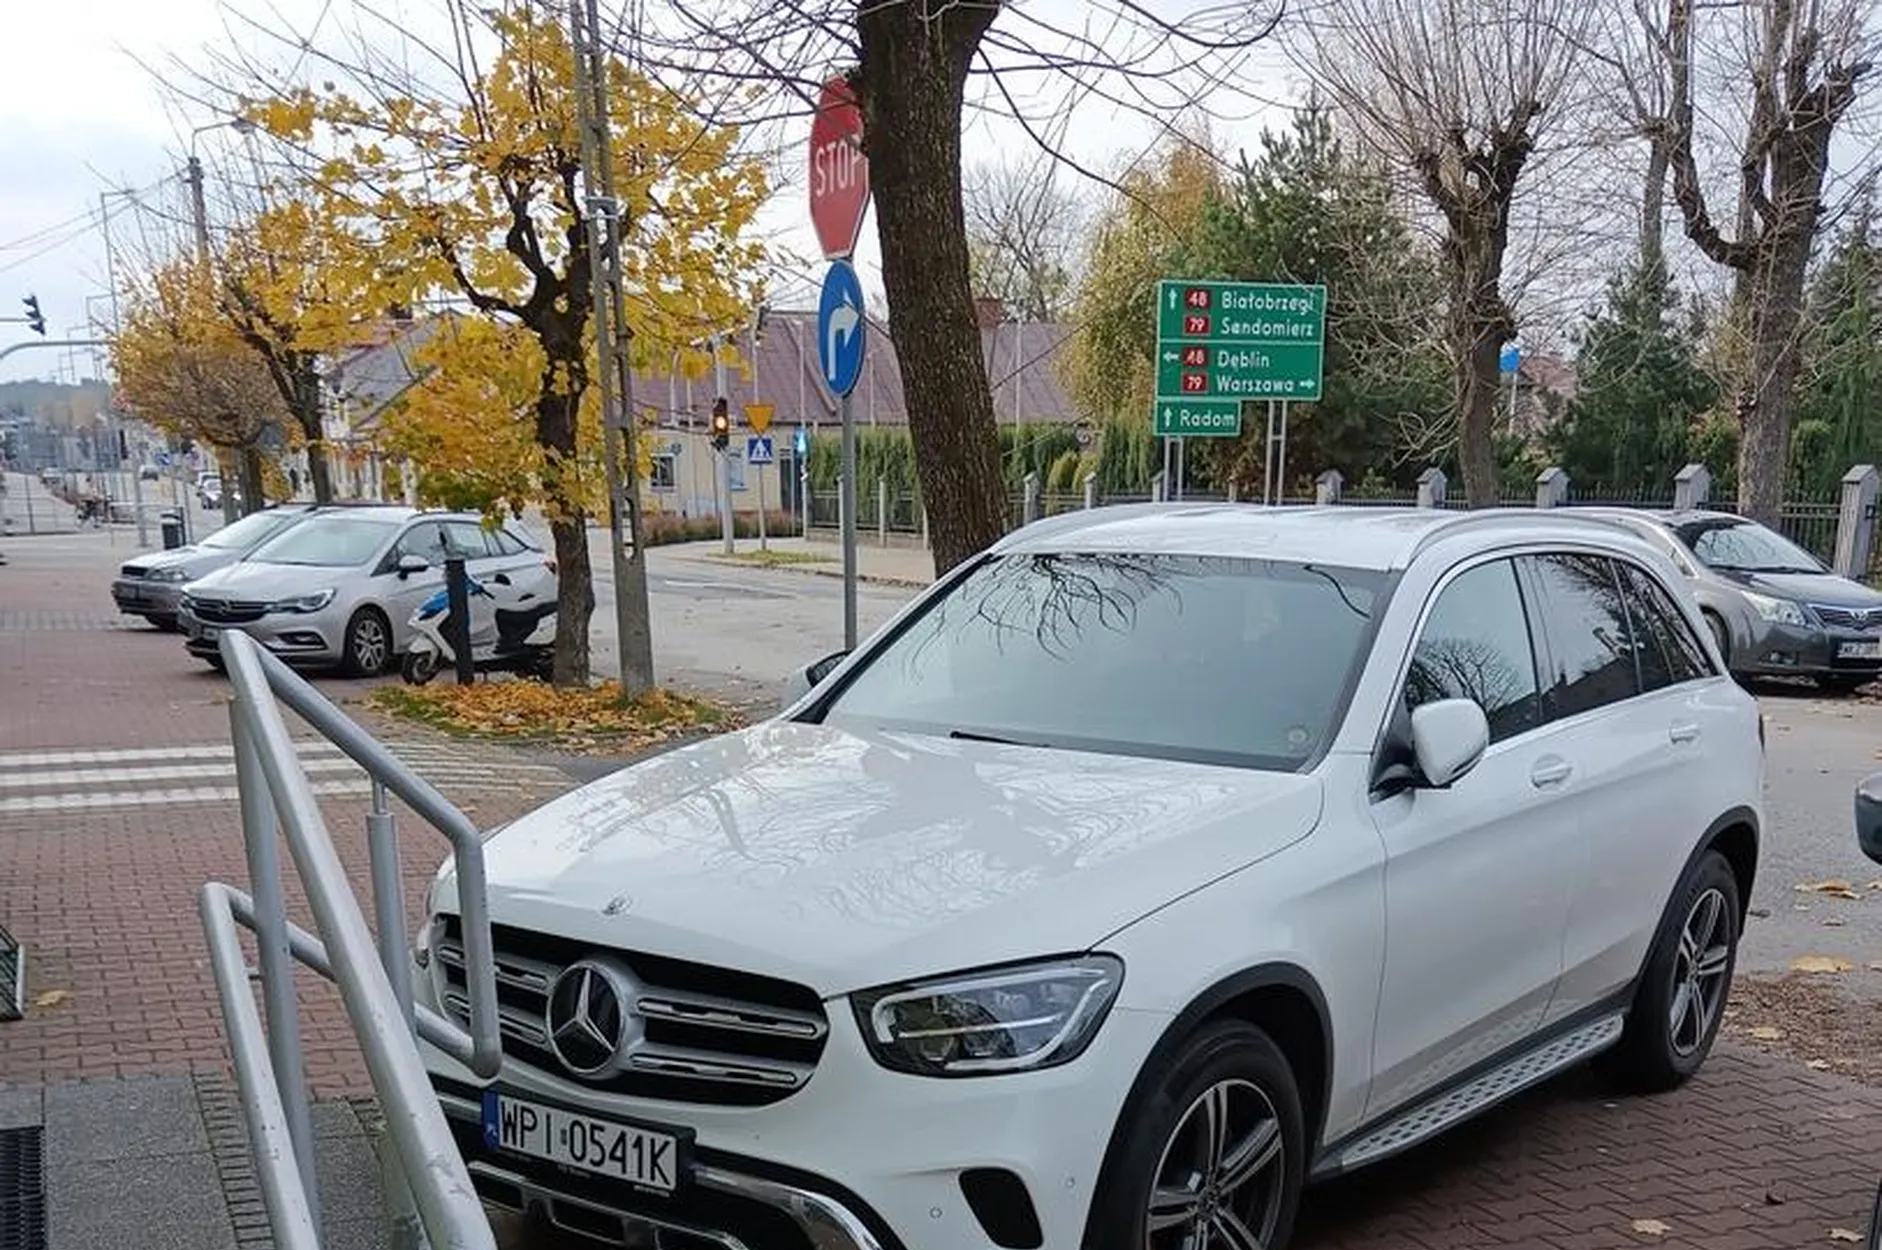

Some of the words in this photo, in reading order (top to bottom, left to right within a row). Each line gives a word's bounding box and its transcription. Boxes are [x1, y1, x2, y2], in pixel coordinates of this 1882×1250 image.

[815, 136, 862, 197] STOP
[1188, 291, 1208, 307] 48
[1221, 290, 1314, 315] Białobrzegi
[1188, 317, 1205, 332] 79
[1221, 317, 1313, 336] Sandomierz
[1184, 350, 1205, 365] 48
[1217, 351, 1270, 371] Dęblin
[1187, 376, 1202, 390] 79
[1216, 374, 1294, 392] Warszawa
[1180, 408, 1235, 427] Radom
[501, 1101, 551, 1154] WPI
[569, 1119, 670, 1186] 0541K
